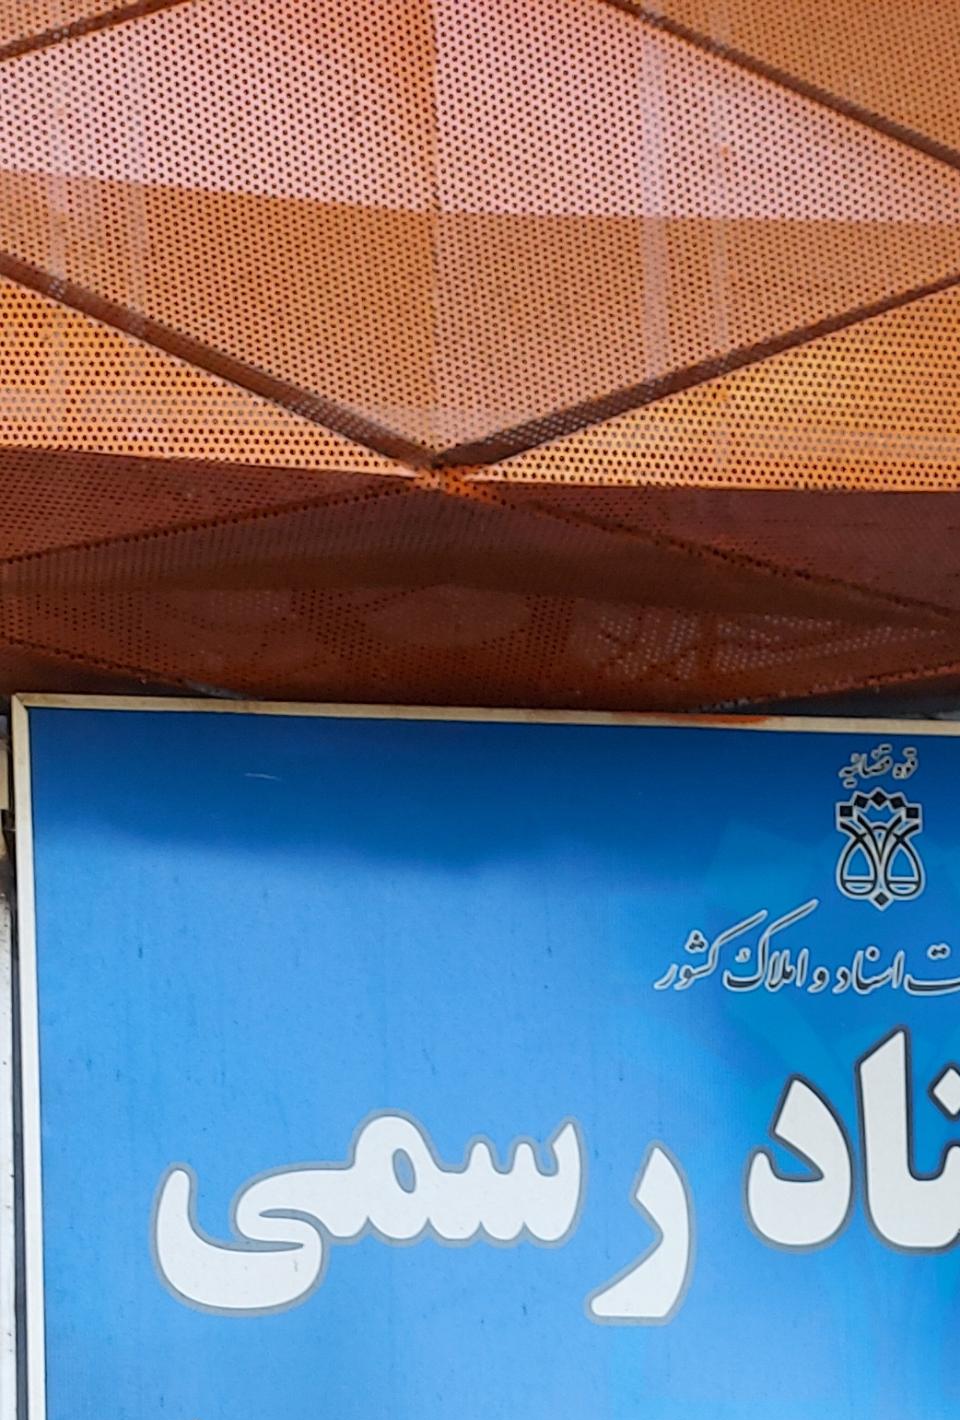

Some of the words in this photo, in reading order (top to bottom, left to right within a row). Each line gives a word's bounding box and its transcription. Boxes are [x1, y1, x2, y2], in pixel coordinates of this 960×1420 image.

[893, 746, 918, 780] قوه
[654, 909, 768, 991] کشور
[723, 898, 819, 993] املاک
[833, 945, 905, 994] اسناد
[807, 966, 830, 993] و
[151, 1108, 693, 1324] رسمی
